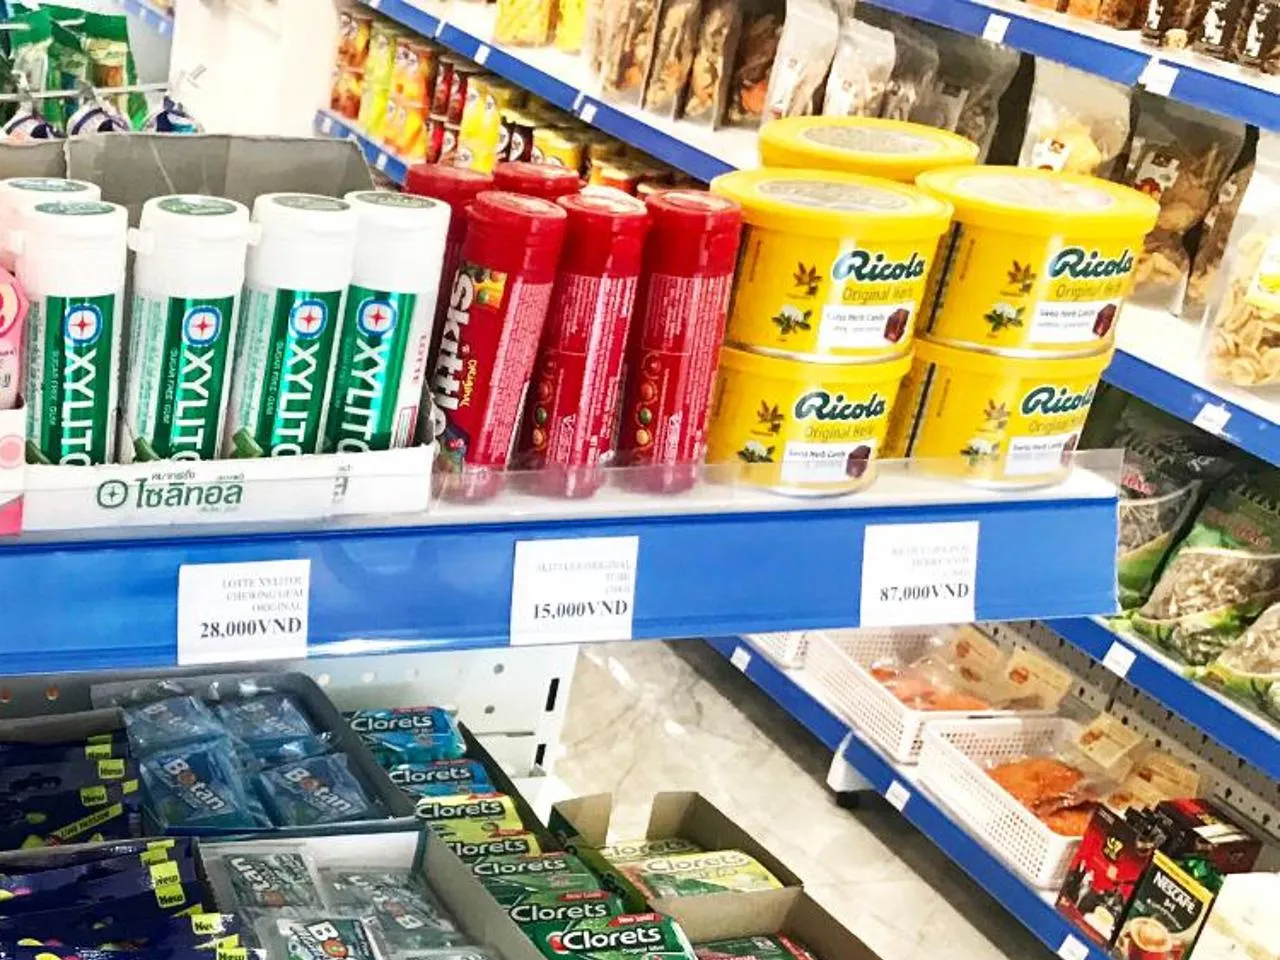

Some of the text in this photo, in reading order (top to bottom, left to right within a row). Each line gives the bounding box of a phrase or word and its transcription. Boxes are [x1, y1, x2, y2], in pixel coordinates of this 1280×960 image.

[833, 250, 925, 281] Ricola
[1049, 248, 1133, 281] Ricola
[431, 269, 475, 437] Skittle
[60, 347, 97, 465] XYLITO
[173, 349, 215, 462] XYLITO
[272, 343, 319, 455] XYLITO
[337, 339, 396, 451] XYLITO
[795, 392, 885, 420] Ricola
[880, 584, 970, 602] 87,000VND
[533, 599, 628, 620] 15,000VND
[200, 616, 303, 640] 28,000VND
[351, 714, 433, 732] Clorets
[390, 767, 471, 783] Clorets
[417, 801, 502, 819] Clorets
[474, 858, 566, 875] Clorets
[511, 904, 607, 922] Clorets
[563, 926, 662, 950] Clorets
